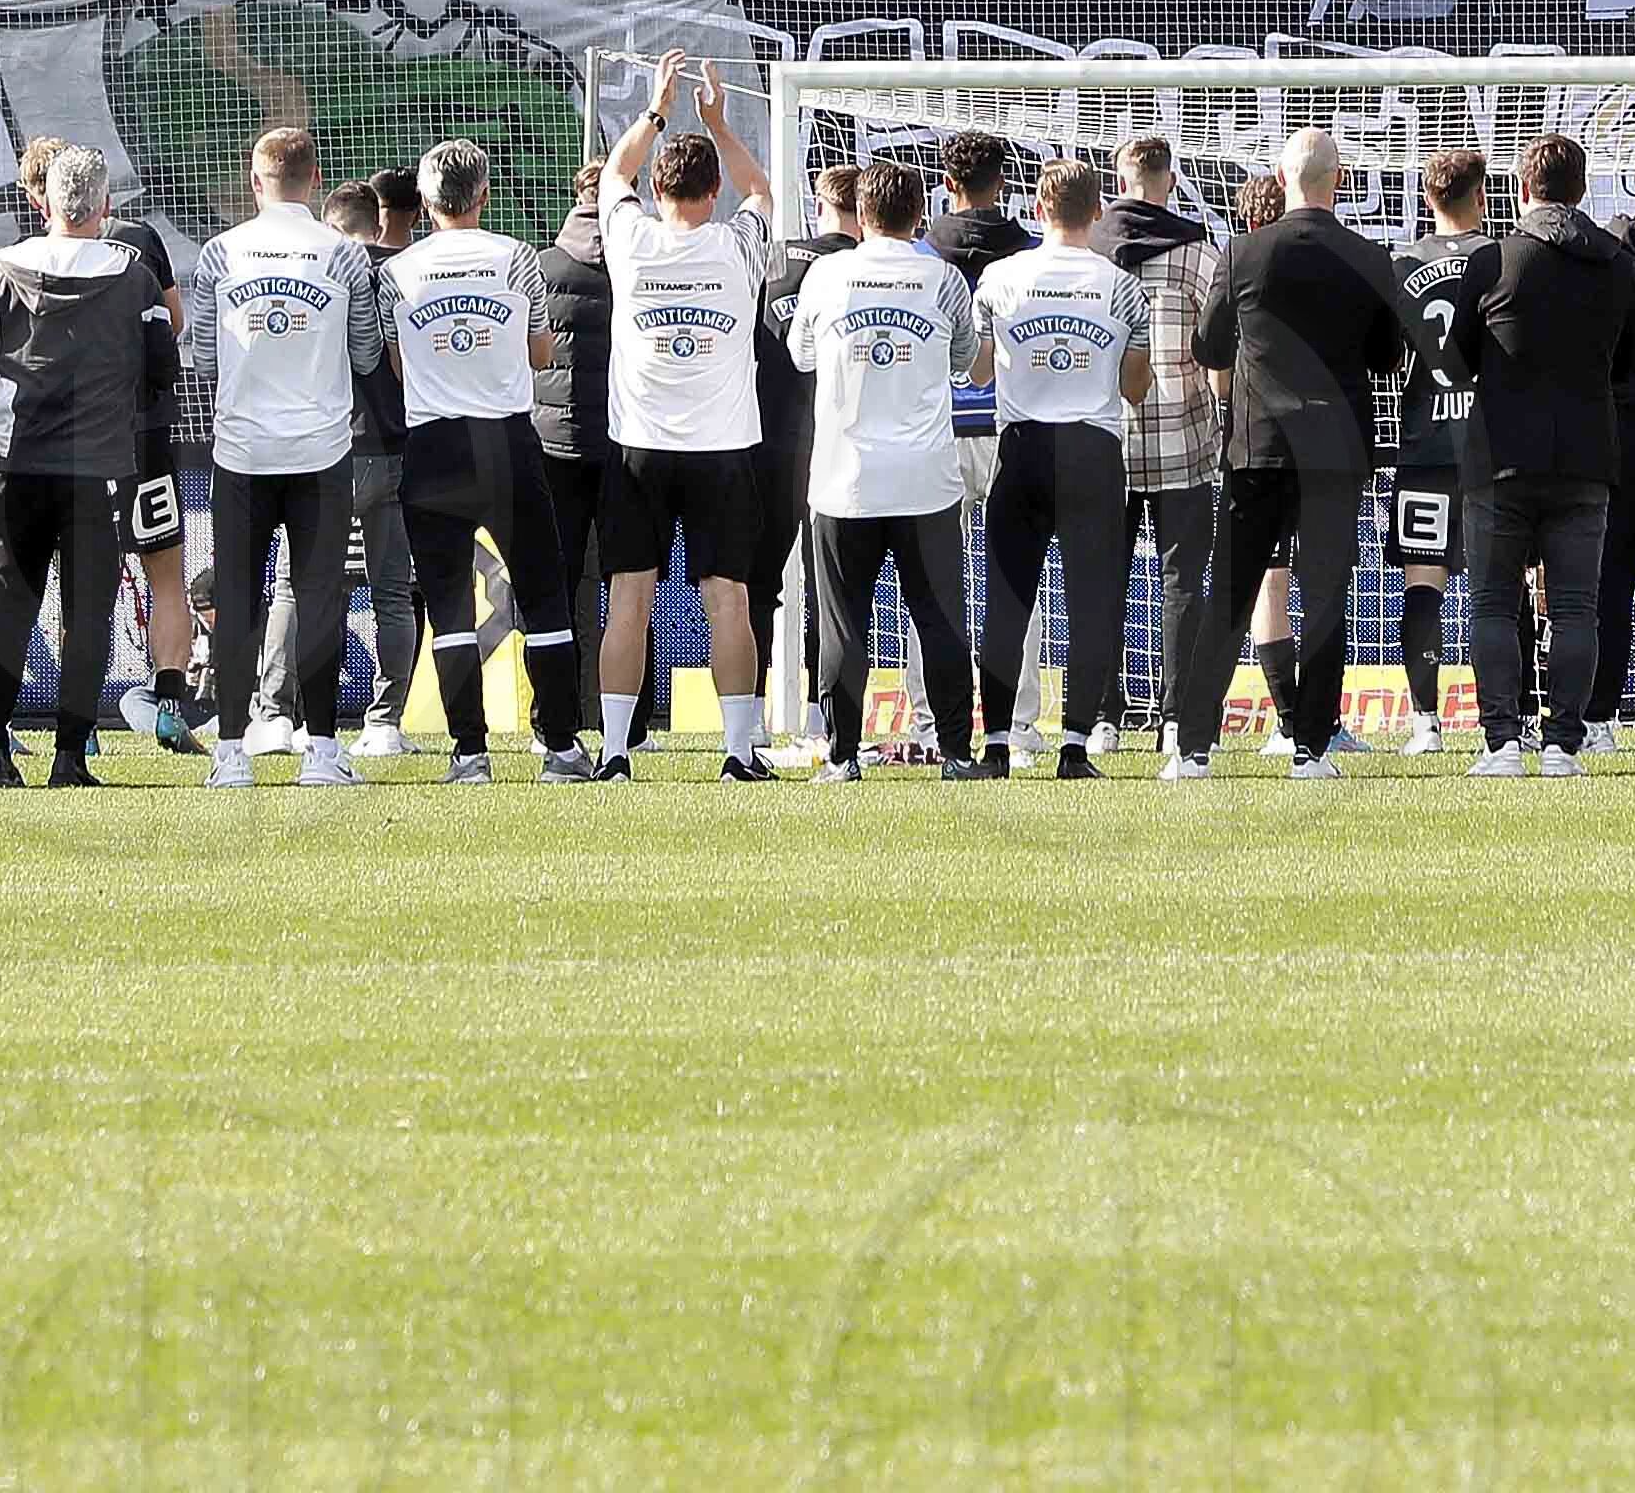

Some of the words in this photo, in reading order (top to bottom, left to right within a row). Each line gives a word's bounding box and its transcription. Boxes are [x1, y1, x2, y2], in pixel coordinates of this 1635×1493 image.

[229, 278, 331, 310] PUNTIGAMER
[411, 296, 512, 329] PUNTIGAMER
[634, 308, 736, 333] PUNTIGAMER
[835, 308, 934, 342] PUNTIGAMER
[1012, 315, 1114, 348] PUNTIGAMER
